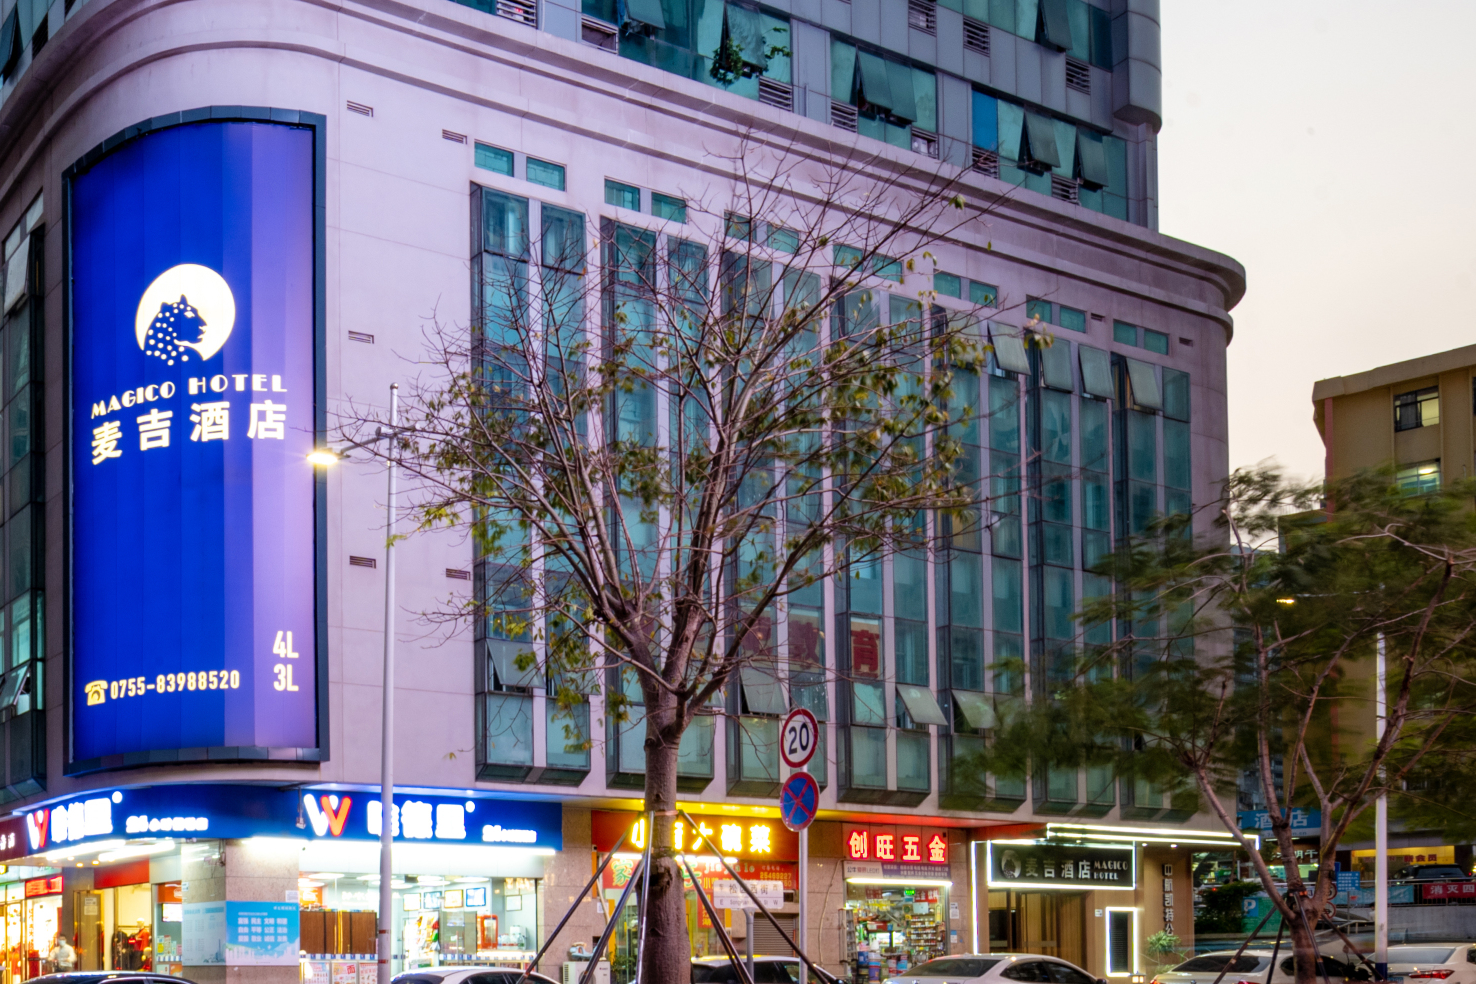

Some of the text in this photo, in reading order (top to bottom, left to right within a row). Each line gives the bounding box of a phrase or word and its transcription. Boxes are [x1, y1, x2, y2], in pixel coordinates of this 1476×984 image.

[91, 374, 288, 419] MAGICO HOTEL
[91, 399, 287, 466] 麦吉酒店
[273, 630, 299, 658] 4L
[110, 670, 240, 700] 0755-83988520
[273, 663, 299, 691] 3L
[788, 722, 810, 754] 20
[1237, 810, 1309, 829] 酒店
[849, 830, 947, 863] 创旺五金
[1025, 858, 1091, 879] 麦吉酒店
[1093, 871, 1119, 880] HOTEL
[1094, 860, 1129, 870] MAGICO
[1430, 884, 1475, 894] 消灭四
